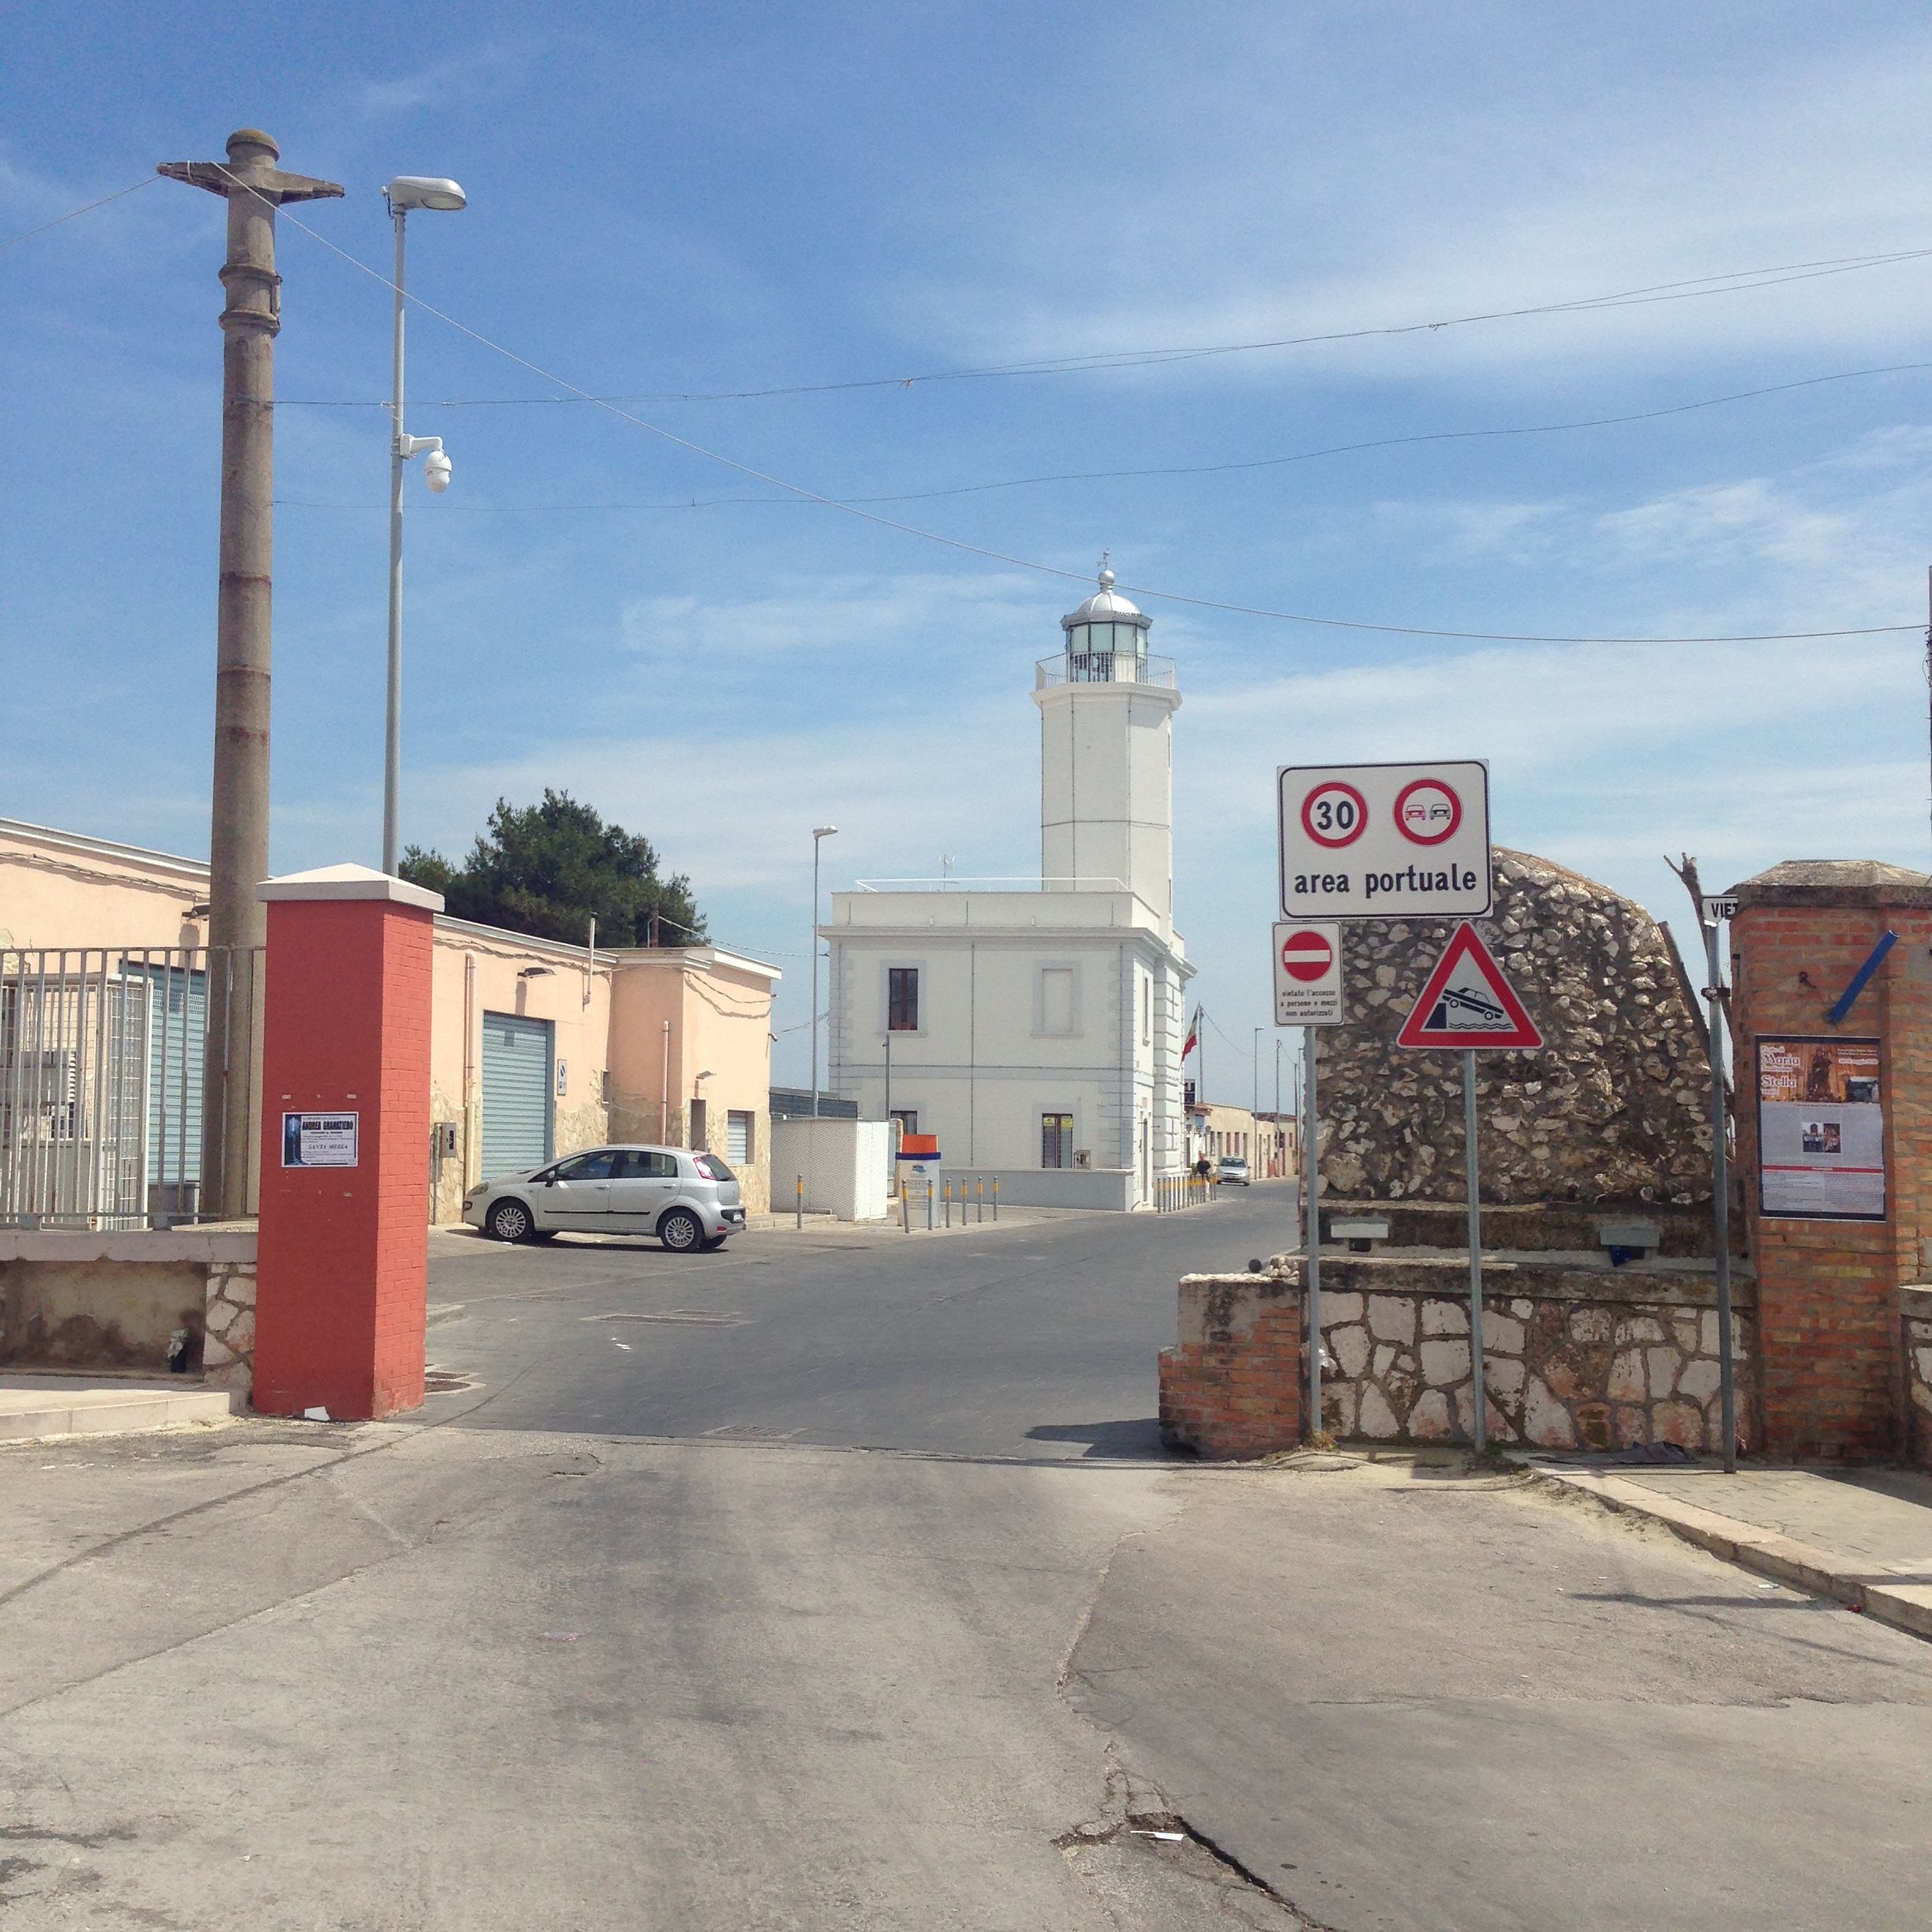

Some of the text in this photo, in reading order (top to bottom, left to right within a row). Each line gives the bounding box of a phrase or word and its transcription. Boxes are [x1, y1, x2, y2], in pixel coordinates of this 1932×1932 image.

[1316, 800, 1354, 830] 30
[1294, 863, 1477, 899] area portuale
[1762, 1054, 1799, 1065] Maria
[1762, 1076, 1795, 1087] Stella
